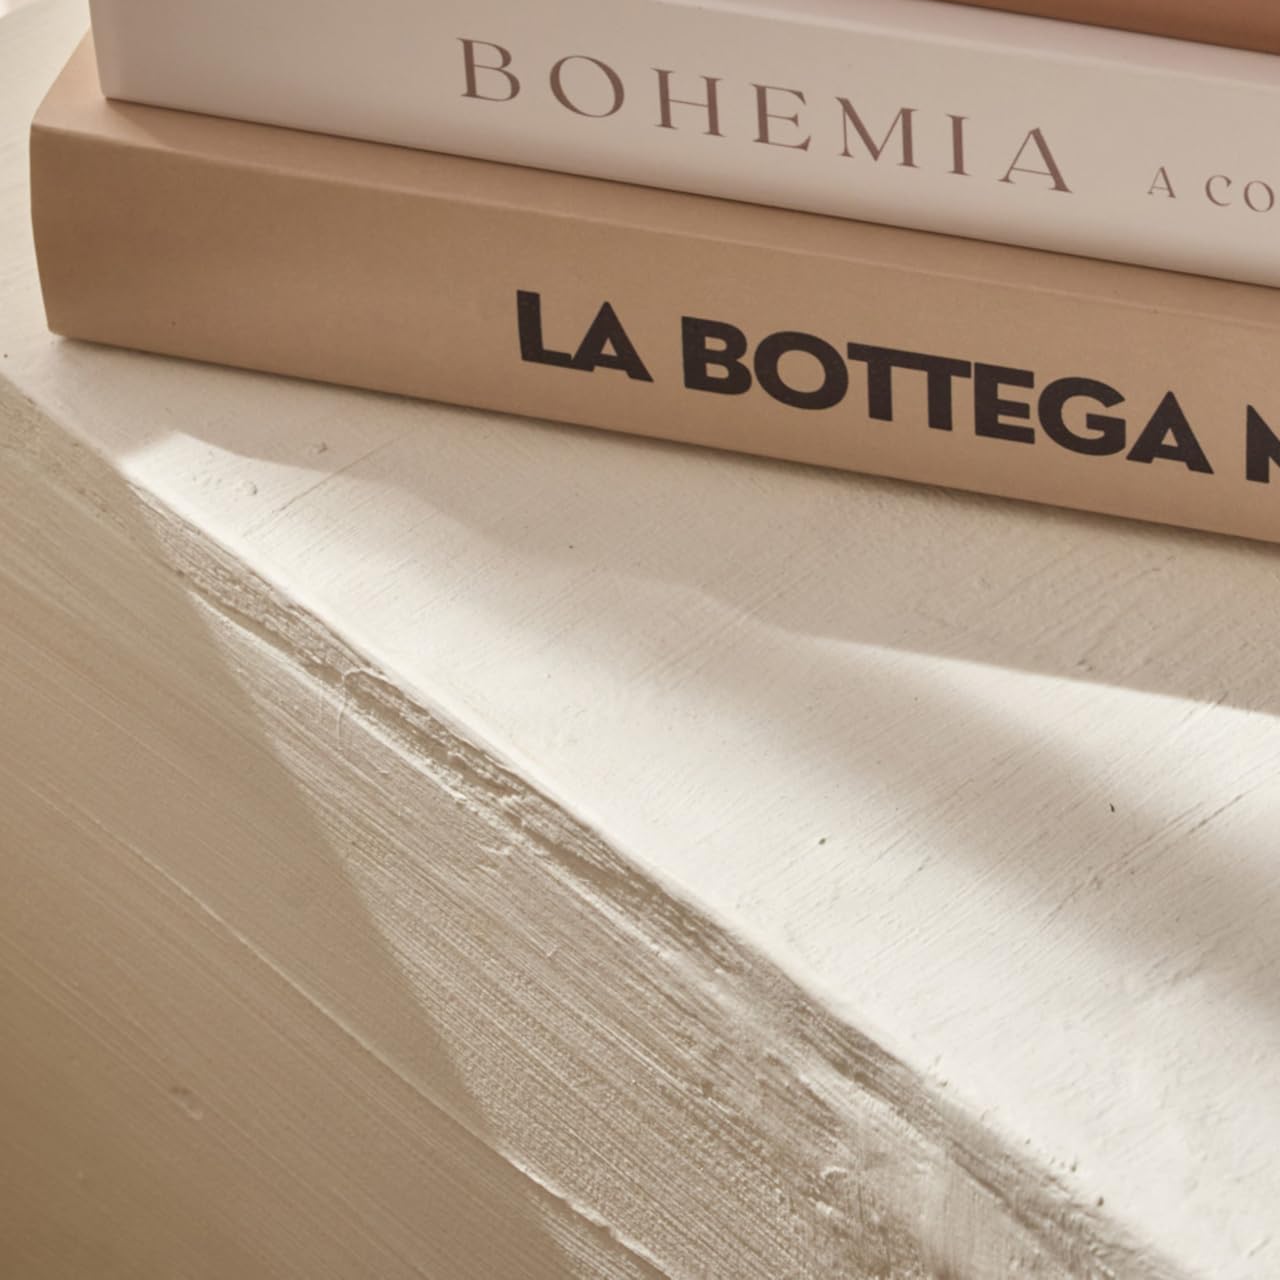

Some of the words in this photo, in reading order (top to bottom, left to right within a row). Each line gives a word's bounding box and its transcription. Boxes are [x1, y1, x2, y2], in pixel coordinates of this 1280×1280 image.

[456, 37, 1074, 193] BOHEMIA
[1147, 166, 1177, 200] A
[516, 290, 654, 383] LA
[681, 316, 1214, 474] BOTTEGA
